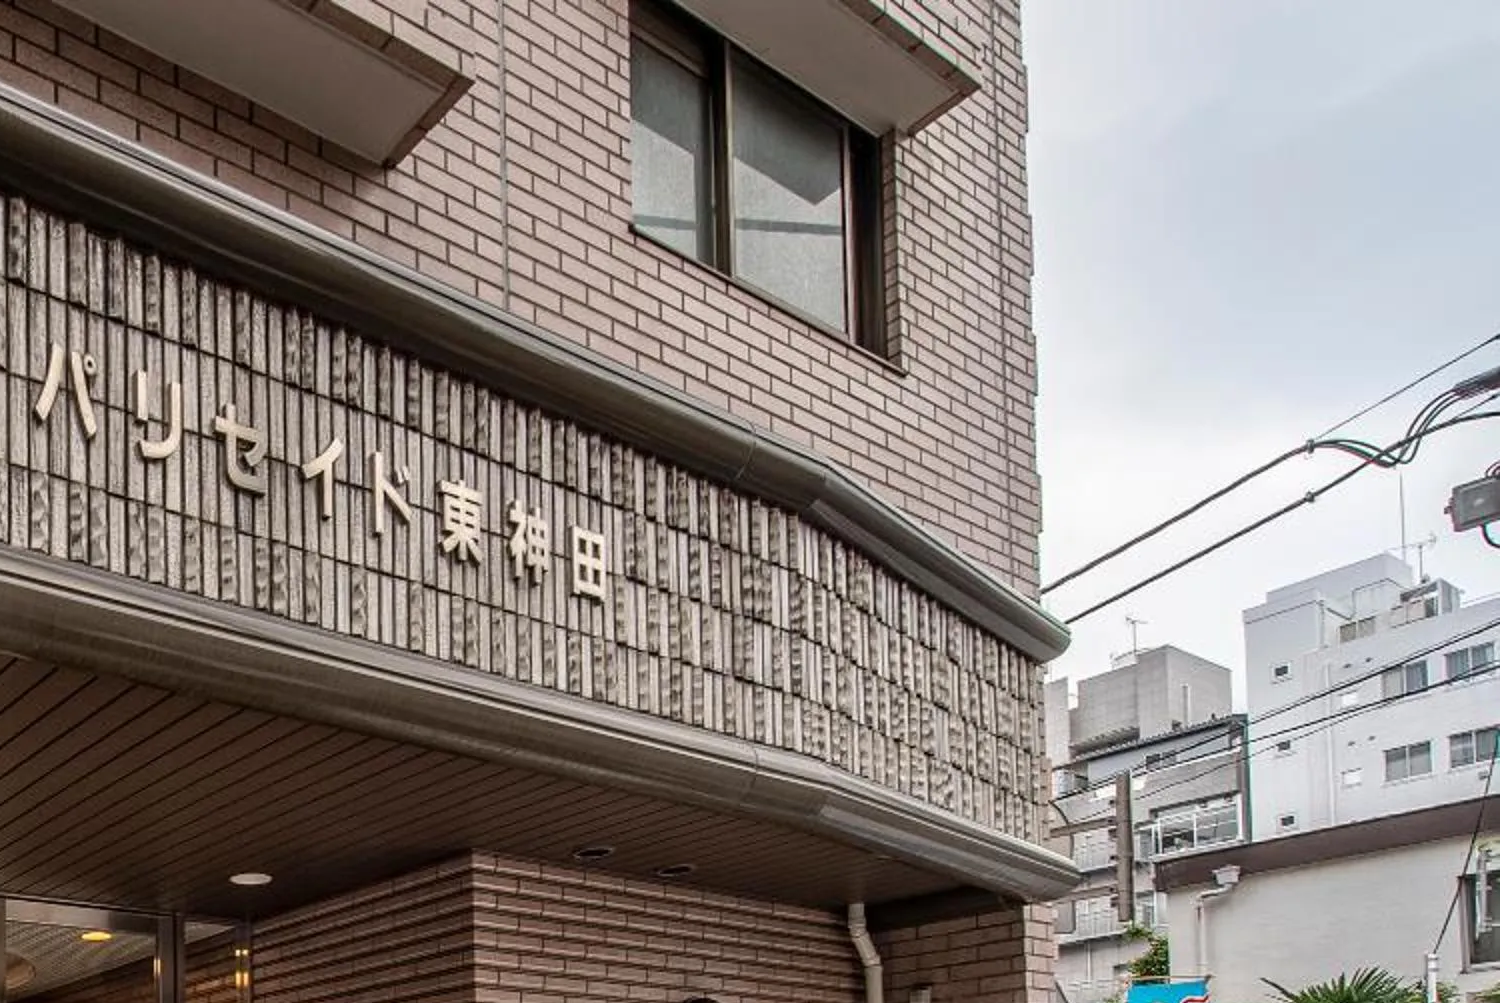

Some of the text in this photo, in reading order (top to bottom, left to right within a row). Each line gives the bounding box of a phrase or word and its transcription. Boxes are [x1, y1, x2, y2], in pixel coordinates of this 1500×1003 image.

[34, 343, 606, 602] パリセイド東神田
